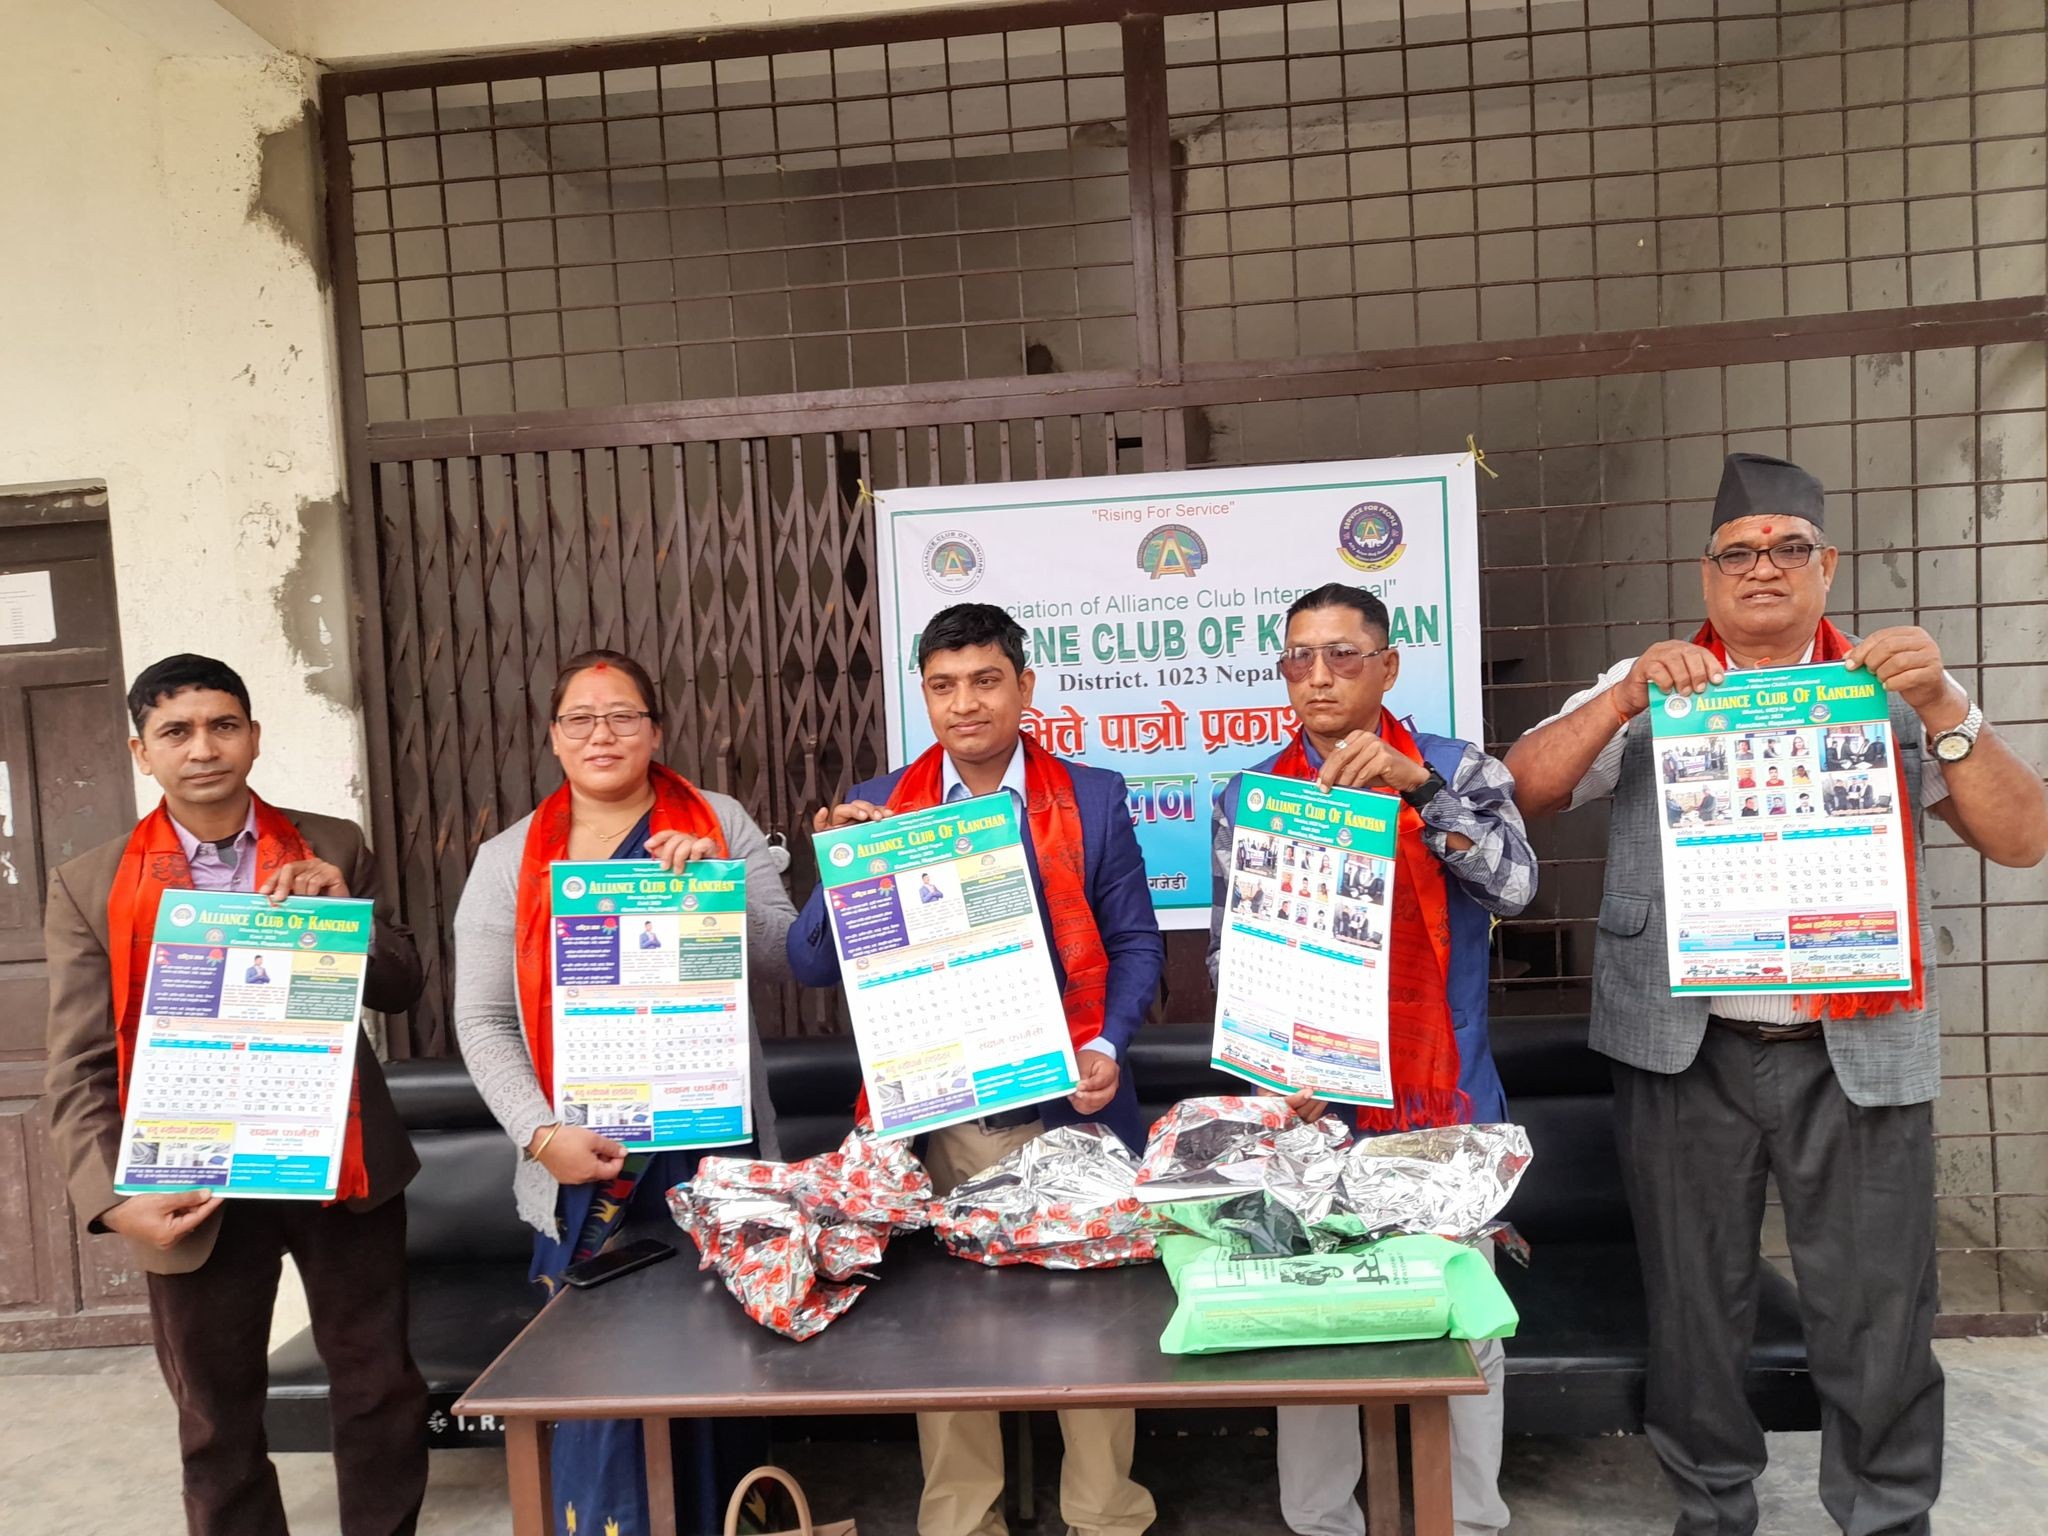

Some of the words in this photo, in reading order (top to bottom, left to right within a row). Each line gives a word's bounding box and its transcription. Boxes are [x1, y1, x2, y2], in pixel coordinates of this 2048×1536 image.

[1092, 509, 1142, 523] "Rising
[1147, 506, 1170, 519] For
[1176, 501, 1235, 517] Service"
[1379, 506, 1398, 527] PEOPLE
[1080, 596, 1100, 615] of
[1106, 590, 1189, 614] Alliance
[1197, 588, 1245, 609] Club
[1092, 619, 1186, 663] CLUB
[1199, 615, 1245, 657] OF
[1058, 669, 1148, 692] District.
[1157, 666, 1208, 687] 1023
[1696, 694, 1751, 712] ALLIANCE
[1756, 691, 1788, 706] CLUB
[1793, 687, 1810, 703] OF
[1816, 684, 1875, 701] KANCHAN
[1099, 700, 1188, 752] पात्रो
